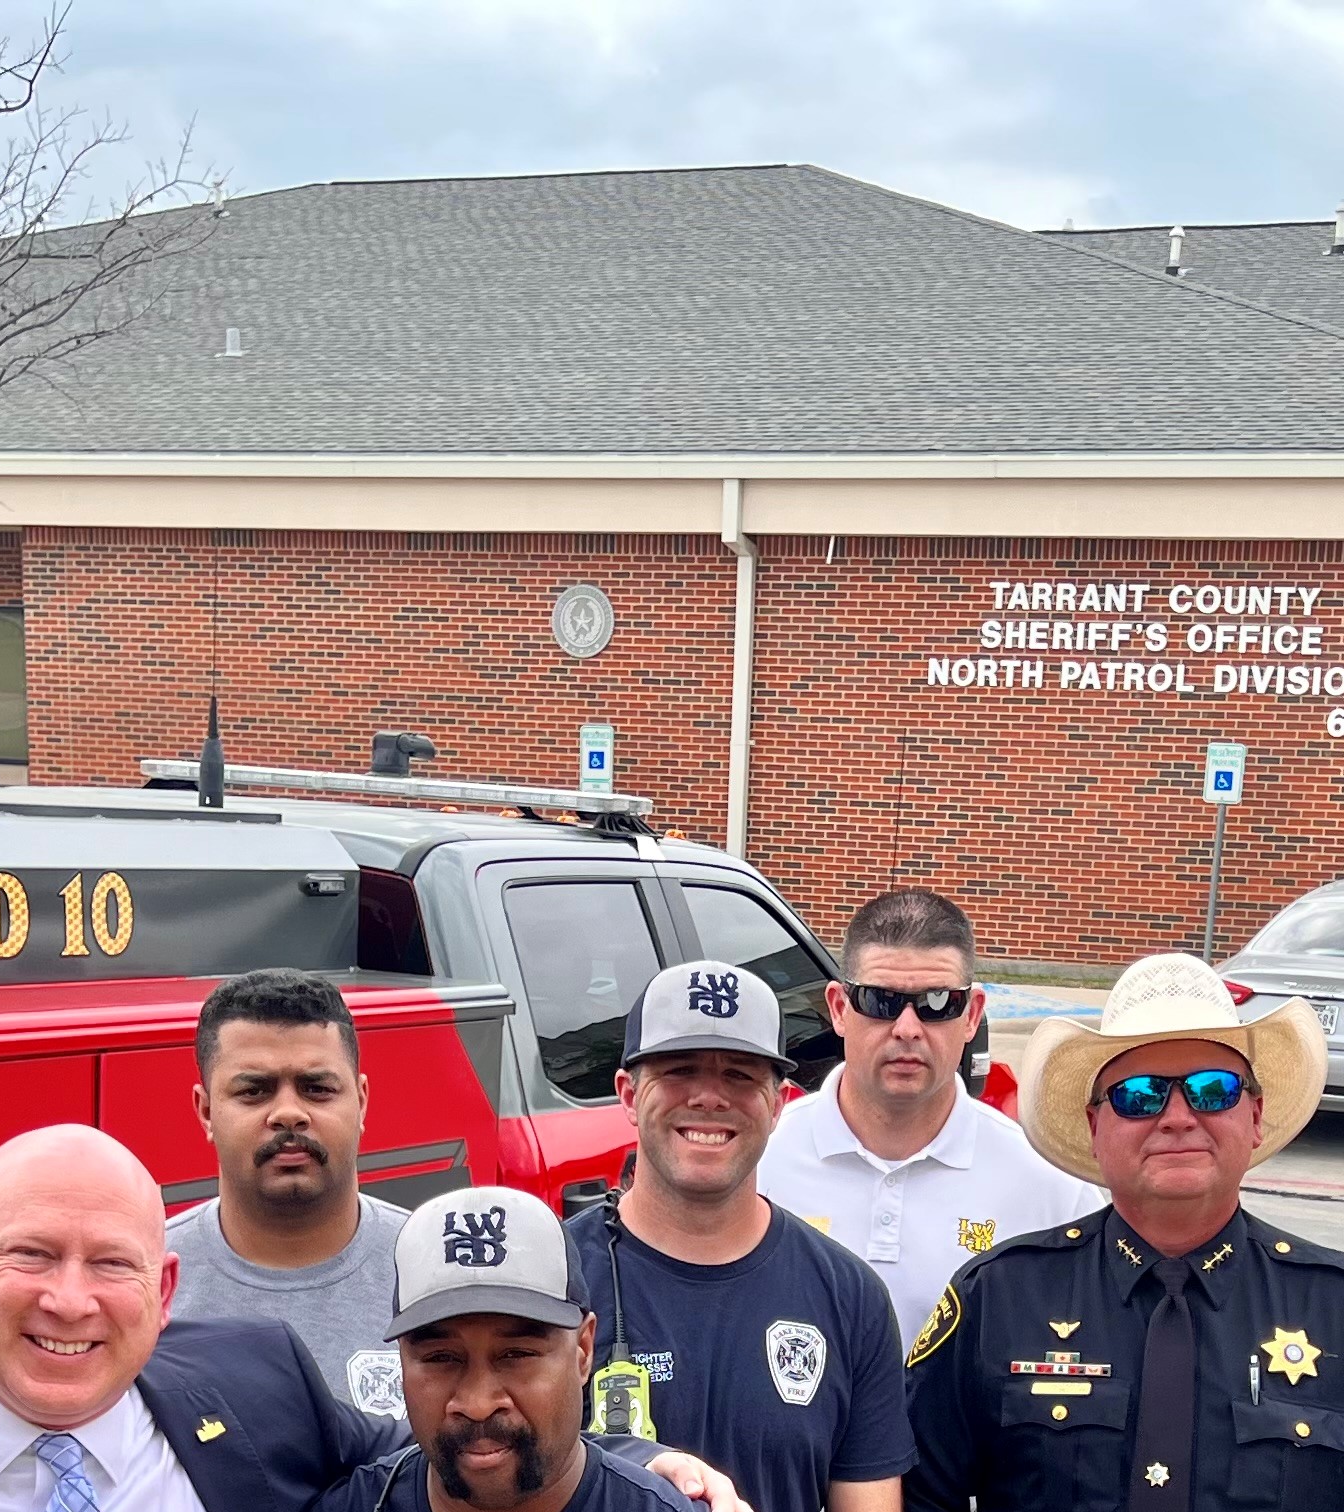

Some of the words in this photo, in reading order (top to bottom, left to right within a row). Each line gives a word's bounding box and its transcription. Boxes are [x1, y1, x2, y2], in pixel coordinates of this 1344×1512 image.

[989, 581, 1150, 613] TARRANT
[1168, 584, 1322, 616] COUNTY
[980, 620, 1167, 652] SHERIFF'S
[1186, 623, 1323, 656] OFFICE
[927, 658, 1043, 688] NORTH
[1060, 661, 1195, 693] PATROL
[57, 871, 135, 957] 10
[773, 1327, 793, 1341] LAKE
[631, 1351, 673, 1364] IGHTER
[650, 1371, 673, 1383] EDIC
[787, 1387, 806, 1397] FIRE
